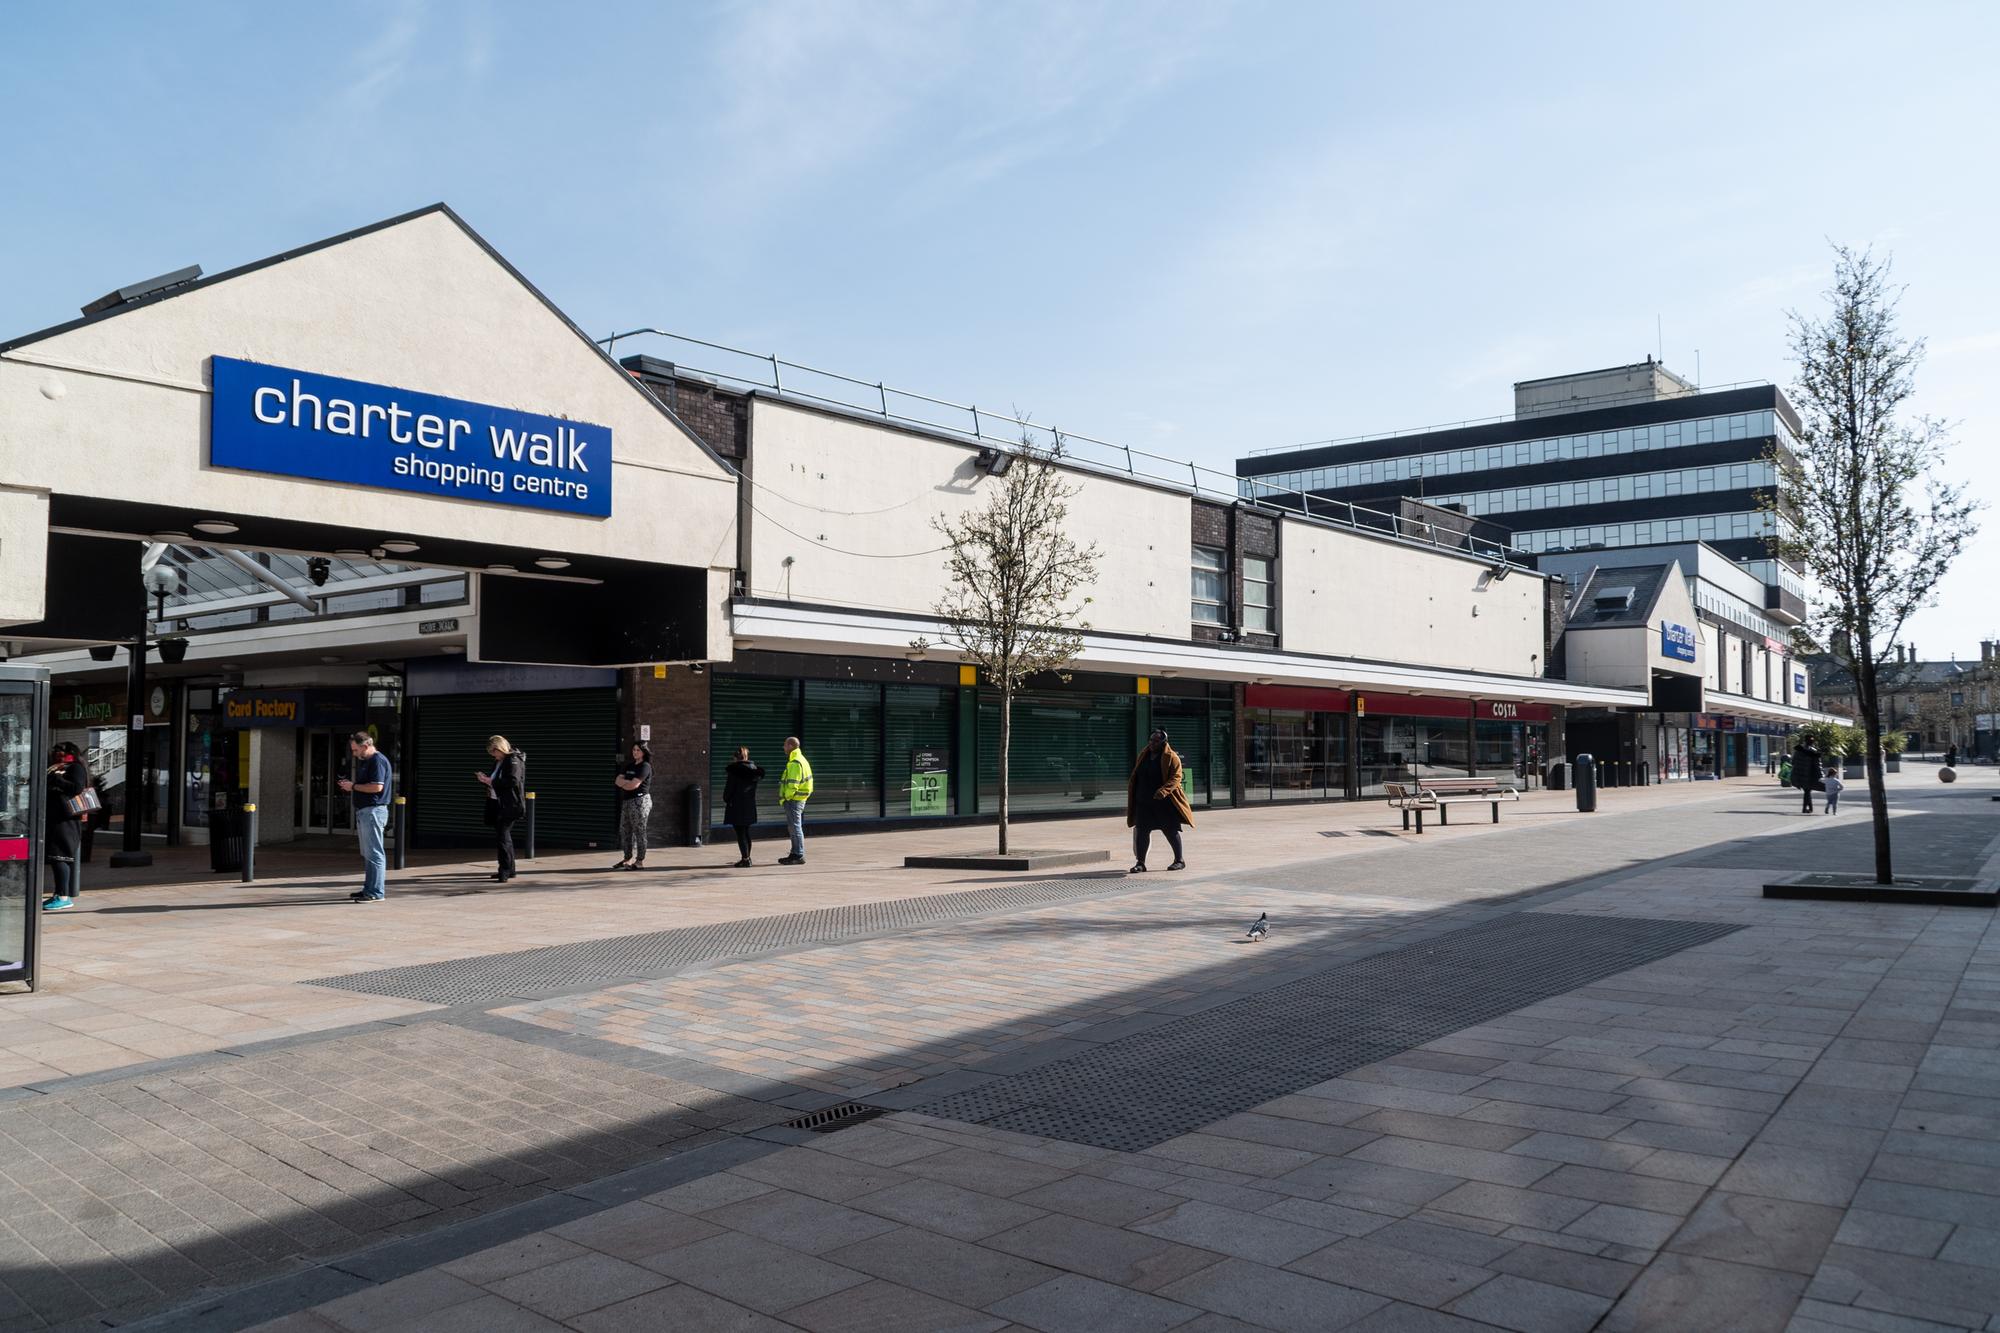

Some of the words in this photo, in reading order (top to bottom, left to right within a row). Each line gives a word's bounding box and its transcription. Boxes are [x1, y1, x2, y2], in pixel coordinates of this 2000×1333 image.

[254, 379, 471, 451] charter
[490, 427, 589, 472] walk
[394, 453, 504, 492] shopping
[513, 473, 589, 500] centre
[73, 694, 112, 721] BARISTA
[227, 699, 253, 717] Card
[255, 698, 296, 721] Factory
[1493, 703, 1517, 718] COSTA
[922, 777, 938, 789] TO
[920, 789, 938, 802] LET
